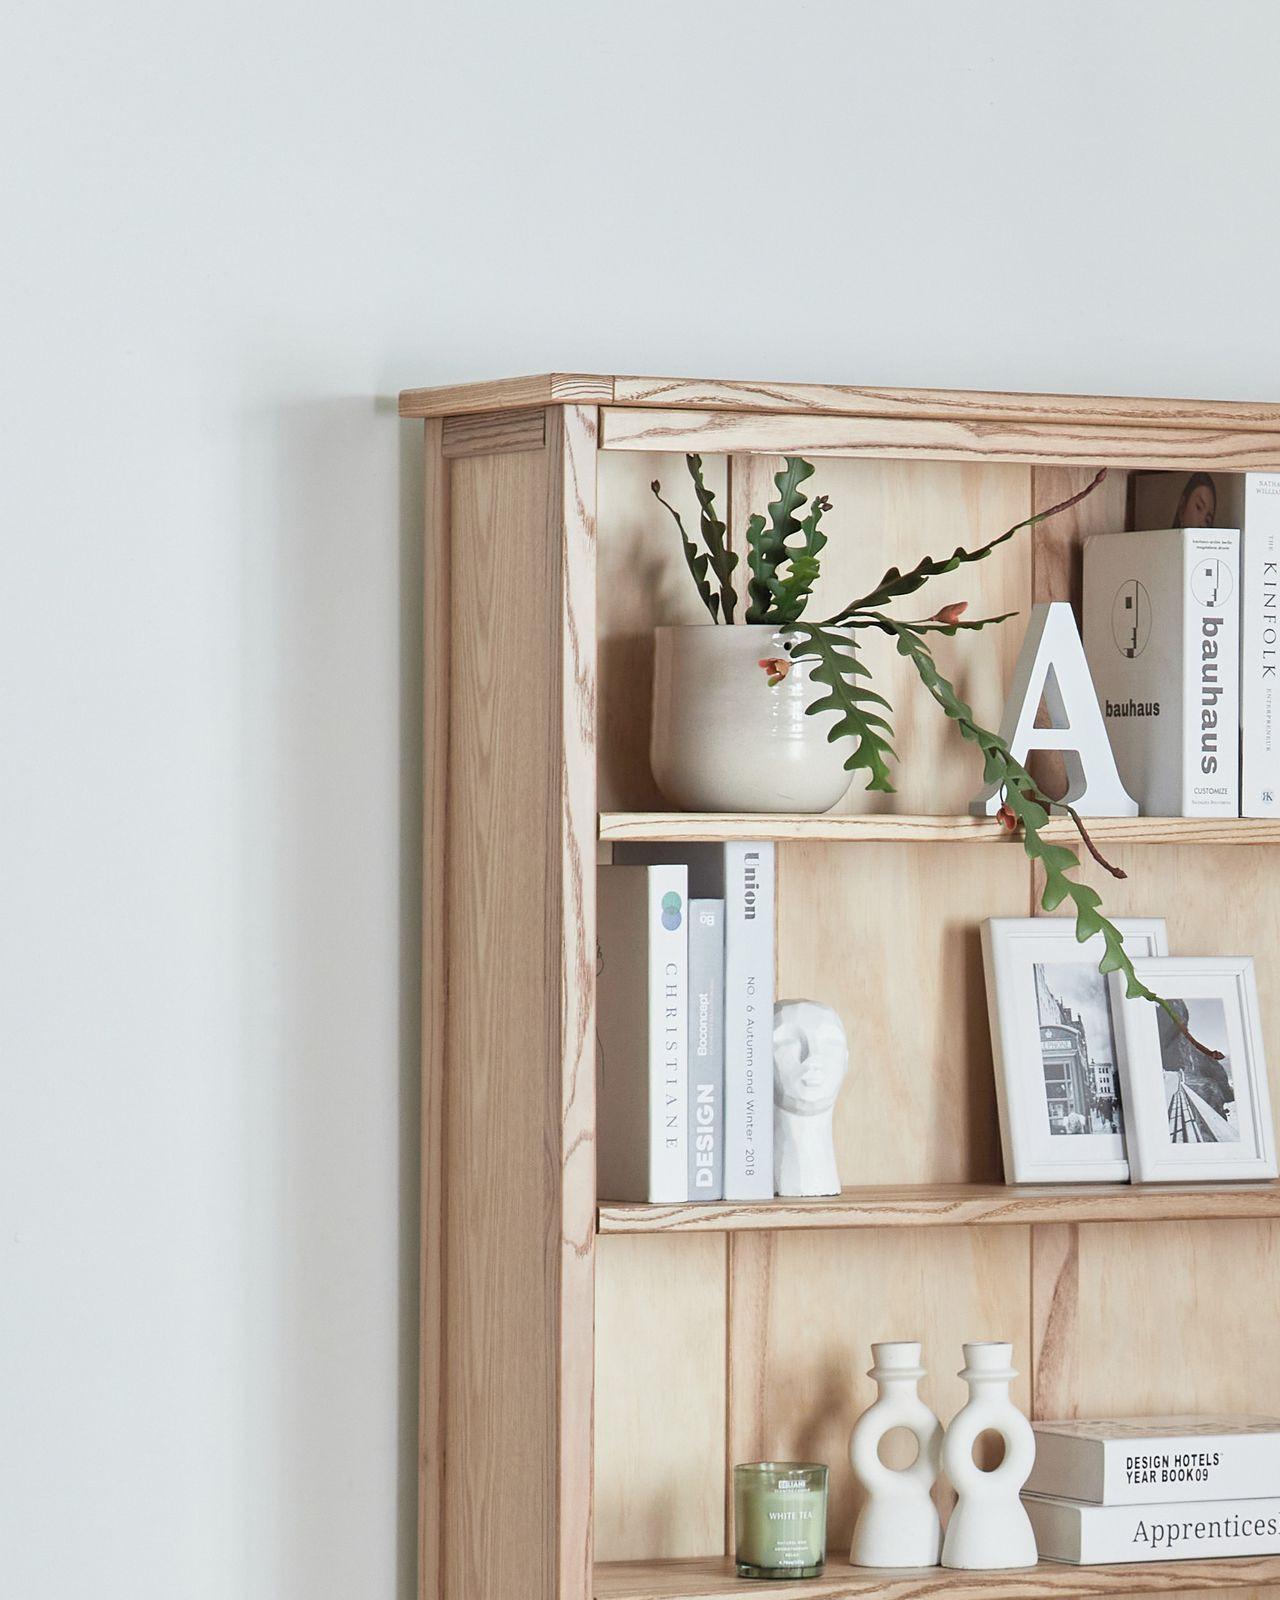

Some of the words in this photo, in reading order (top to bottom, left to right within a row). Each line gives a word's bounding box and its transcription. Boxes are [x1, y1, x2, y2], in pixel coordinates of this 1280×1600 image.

[1262, 562, 1277, 678] KINFOLK
[1105, 698, 1160, 718] bauhaus
[1201, 617, 1224, 775] bauhaus
[744, 852, 760, 920] Union
[745, 1004, 754, 1013] 6
[665, 962, 678, 1149] CHRISTIANE
[745, 1018, 755, 1067] Autumn
[746, 1069, 755, 1094] and
[695, 1083, 714, 1187] DESIGN
[745, 1099, 755, 1142] Winter
[745, 1148, 755, 1176] 2018
[1126, 1455, 1170, 1470] DESIGN
[1126, 1470, 1157, 1485] YEAR
